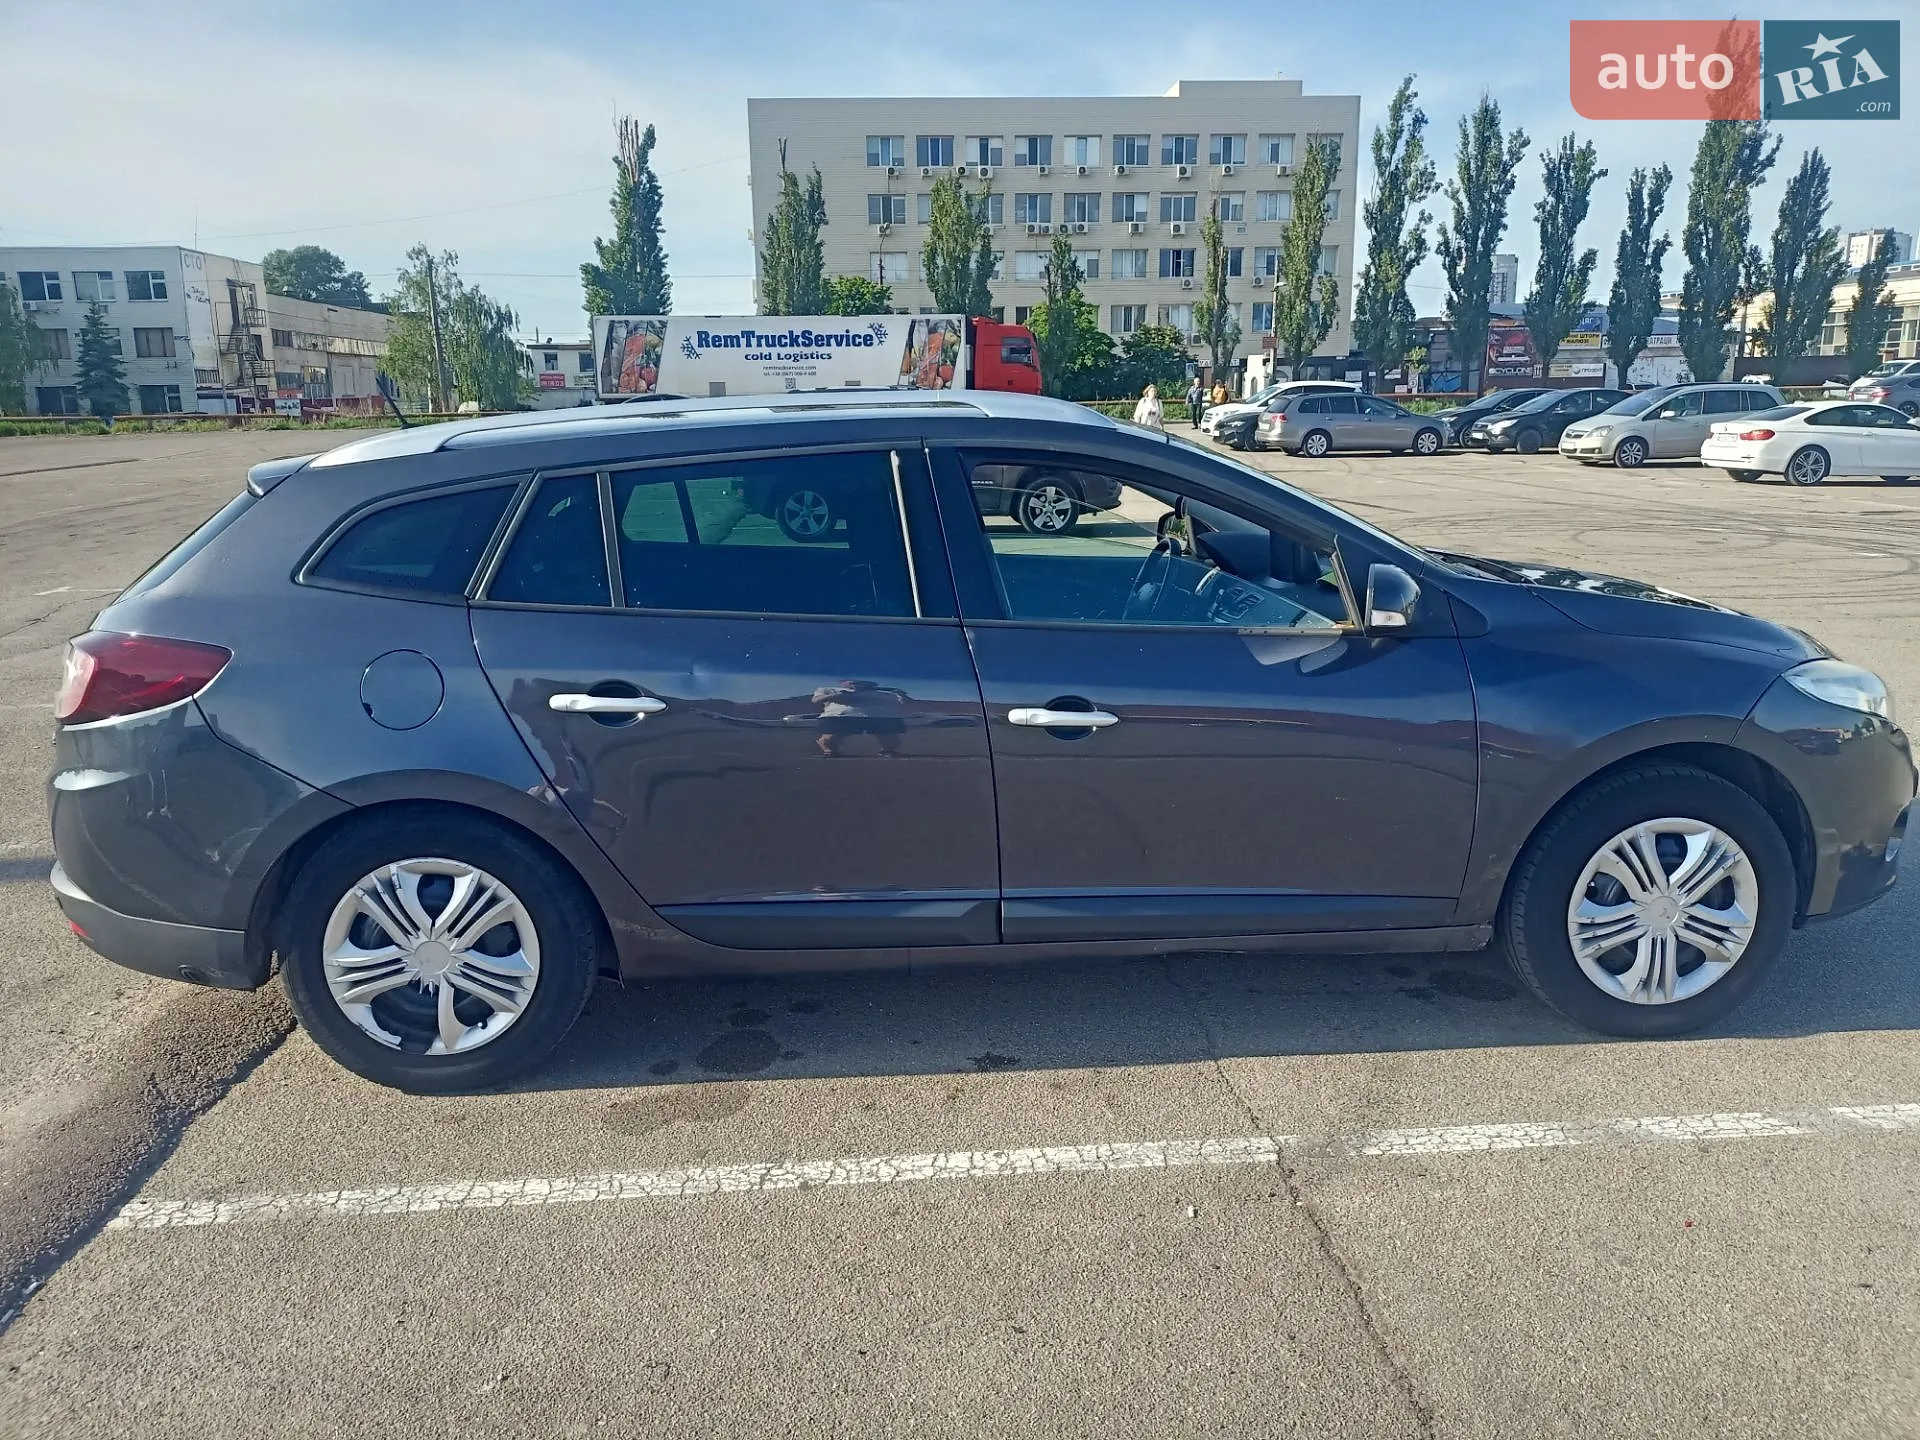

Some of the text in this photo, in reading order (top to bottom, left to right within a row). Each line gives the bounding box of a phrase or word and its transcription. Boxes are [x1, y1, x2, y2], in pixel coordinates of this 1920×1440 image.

[696, 329, 874, 348] RemTruckService
[744, 351, 833, 363] cold Logistics
